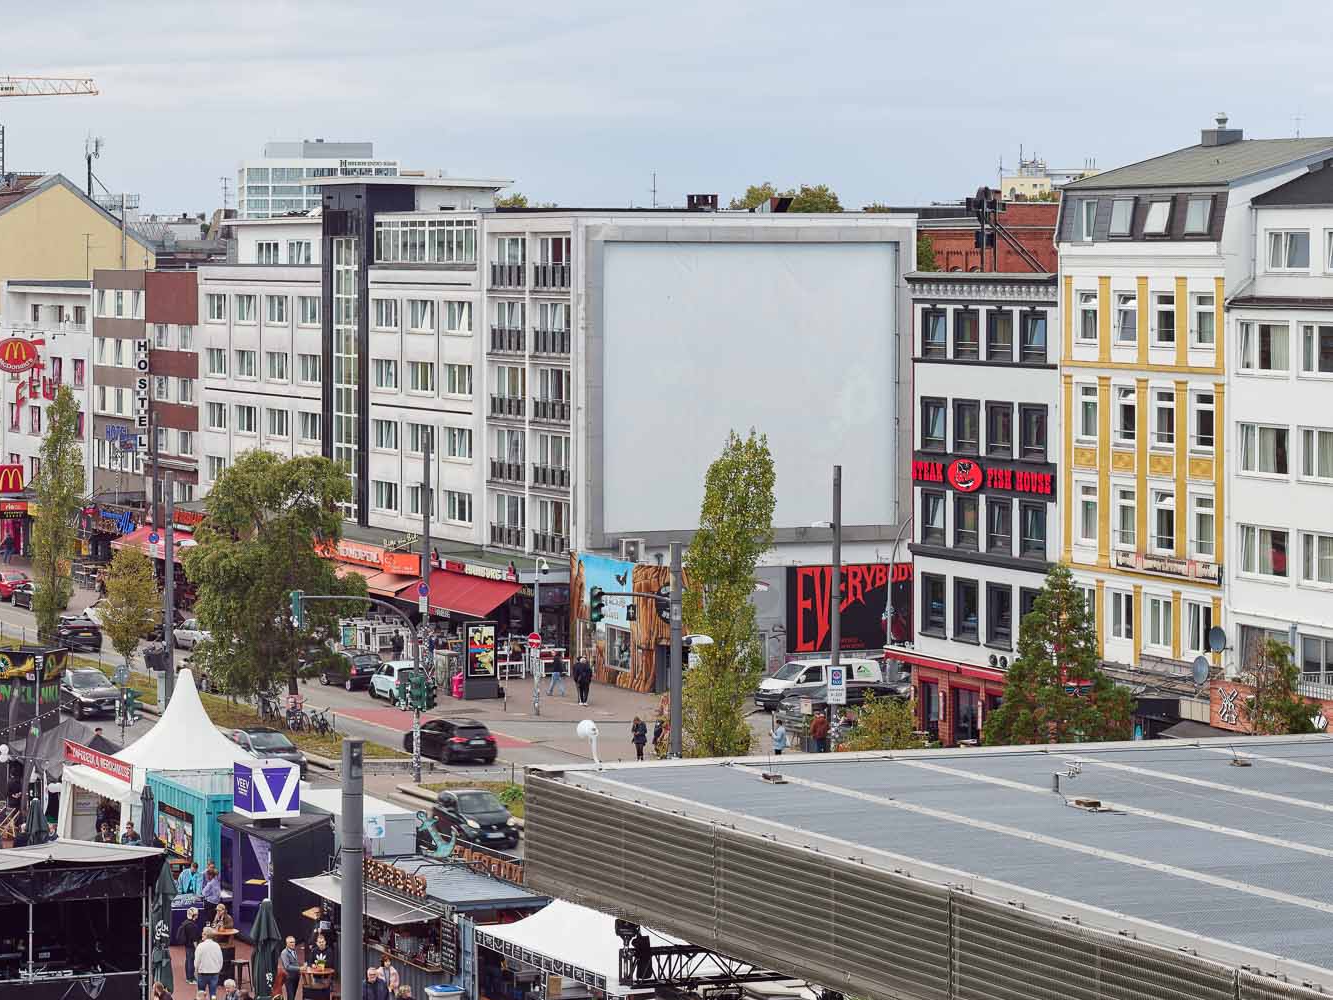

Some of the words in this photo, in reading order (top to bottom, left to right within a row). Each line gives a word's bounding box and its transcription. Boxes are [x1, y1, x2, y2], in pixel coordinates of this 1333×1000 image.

[137, 340, 148, 447] HOSTEL
[912, 461, 944, 482] STEAK
[986, 469, 1013, 489] FISH
[1016, 472, 1052, 494] HOUSE
